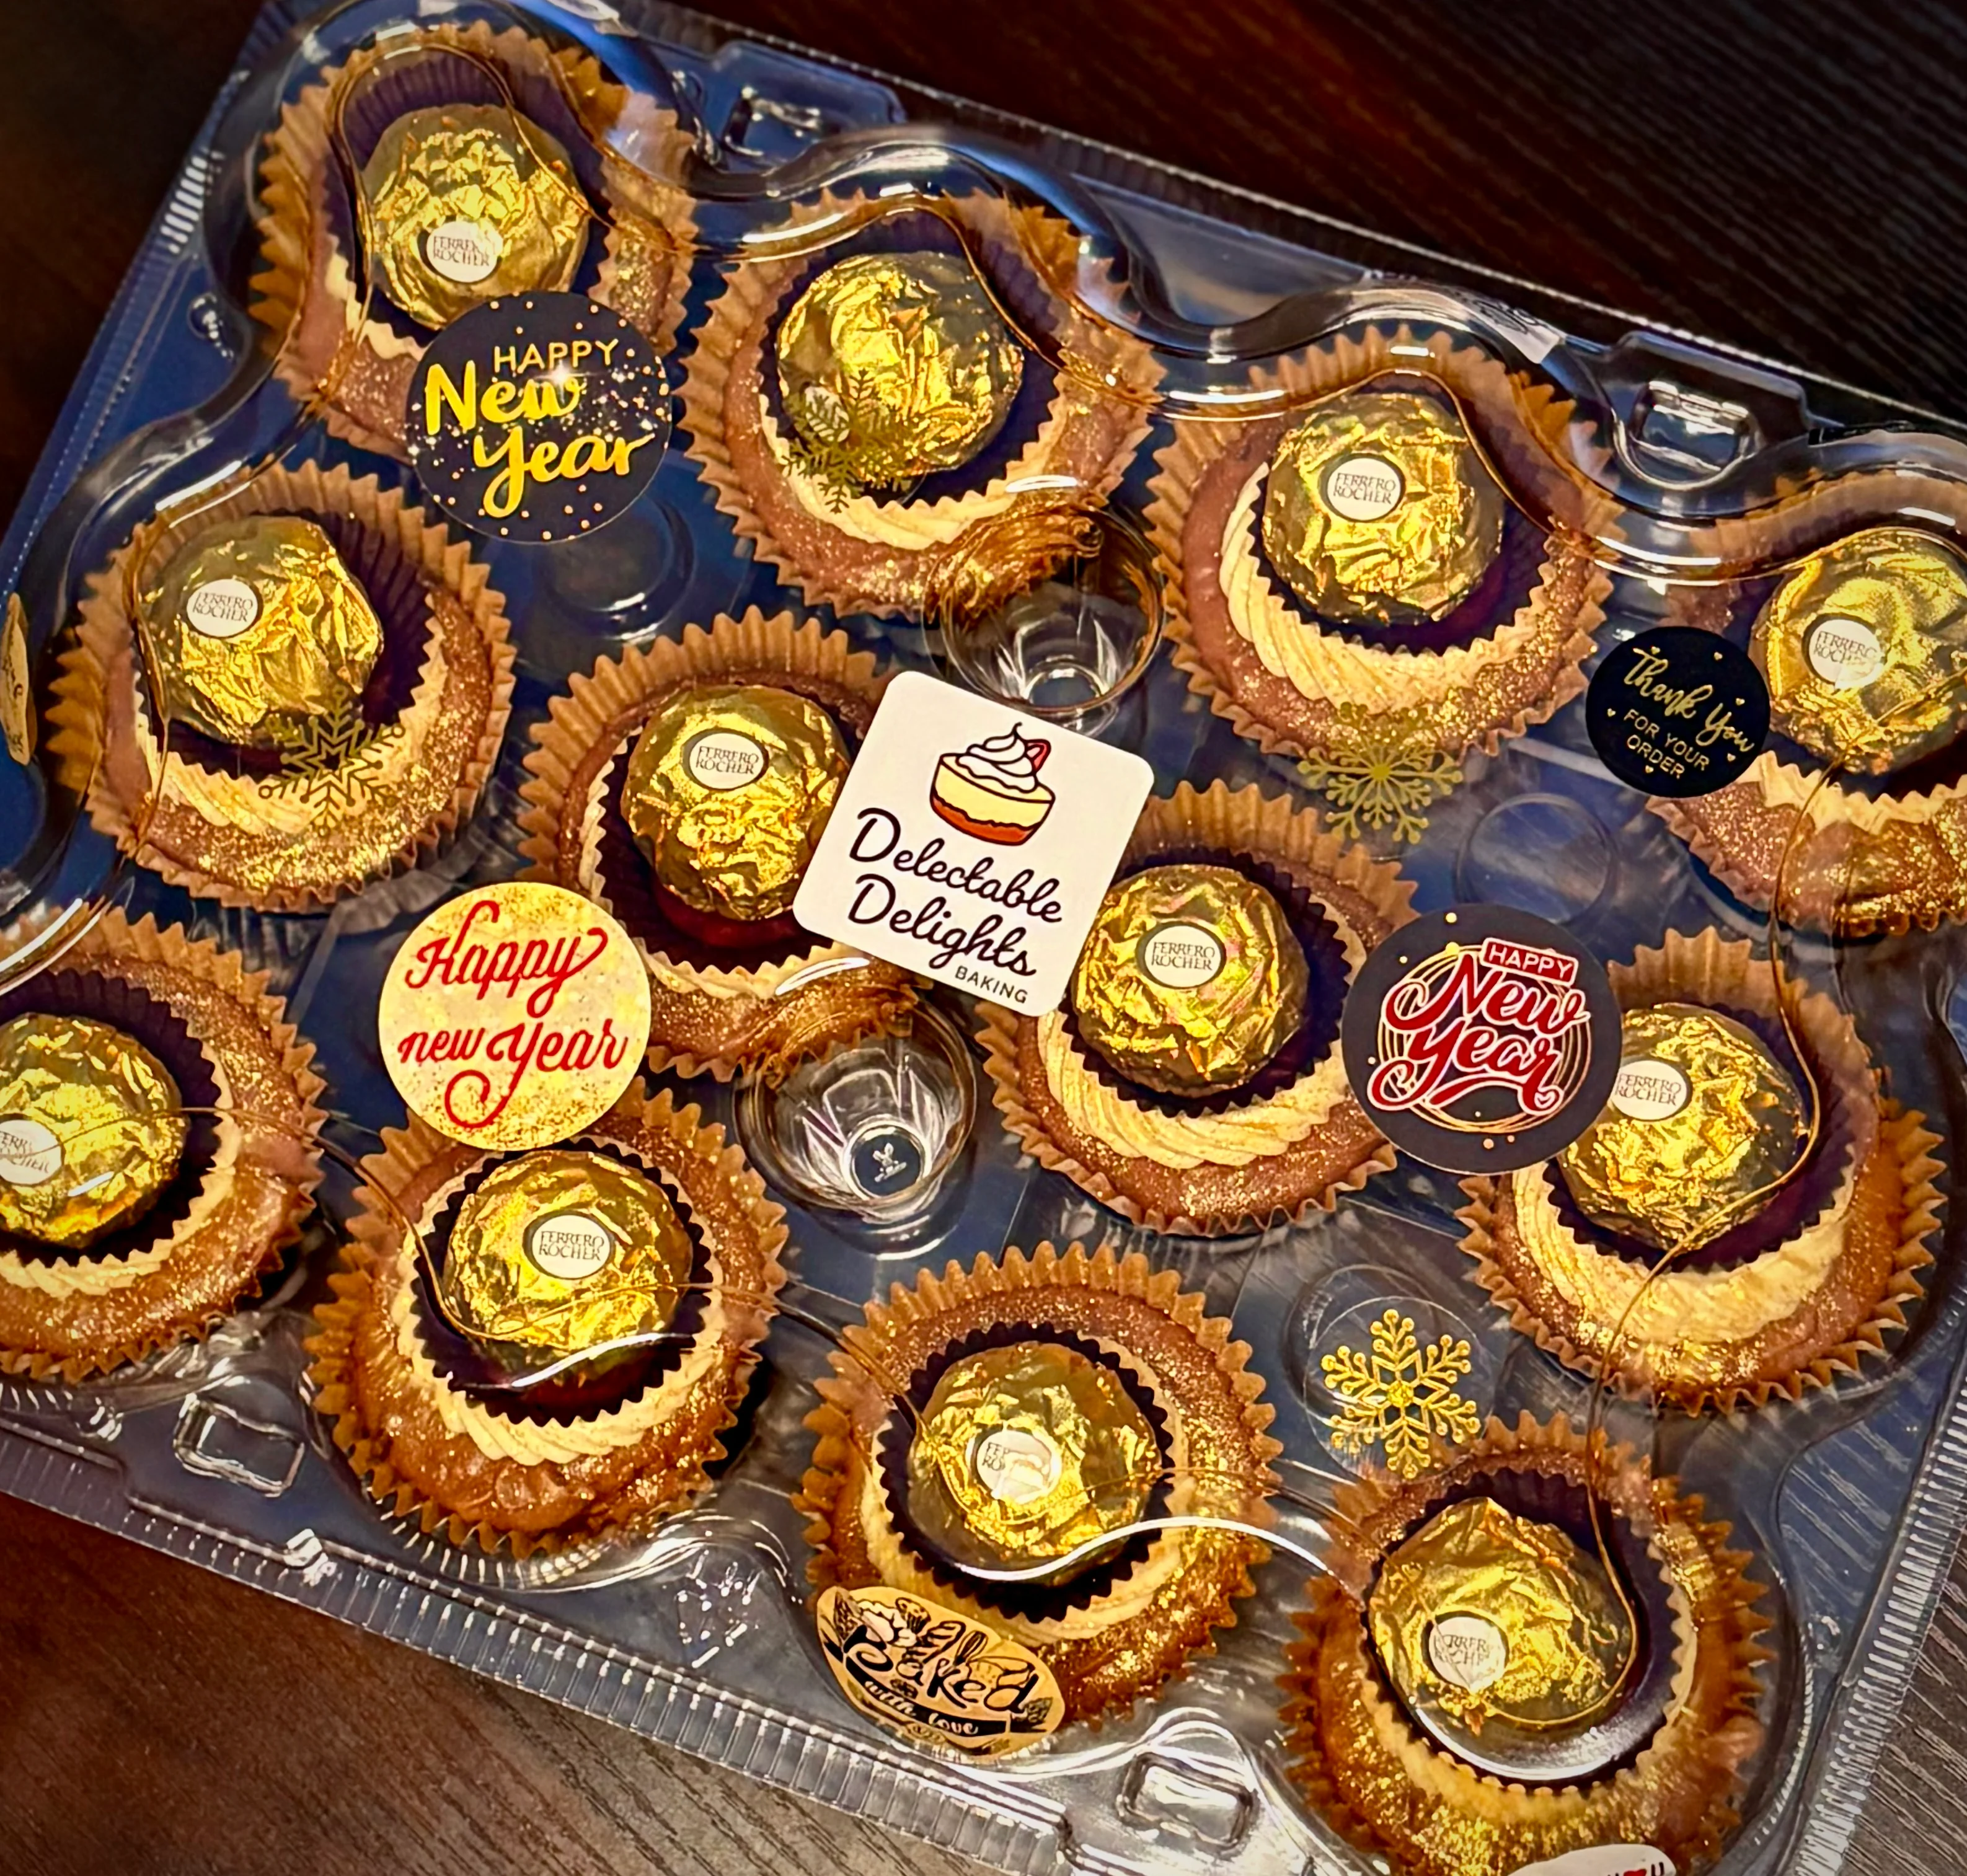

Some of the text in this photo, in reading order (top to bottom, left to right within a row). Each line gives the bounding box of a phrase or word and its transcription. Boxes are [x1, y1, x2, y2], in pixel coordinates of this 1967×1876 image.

[433, 249, 490, 266] ROCHER
[494, 338, 619, 374] HAPPY
[425, 359, 588, 436] New
[1333, 486, 1392, 505] ROCHER
[1335, 472, 1397, 492] FERRERO
[192, 602, 248, 623] ROCHER
[193, 591, 254, 611] FERRERO
[1624, 648, 1713, 719] Thank
[698, 746, 759, 764] FERRERO
[1624, 709, 1710, 771] FOR YOUR
[1627, 734, 1685, 779] ORDER
[696, 758, 754, 775] ROCHER
[849, 808, 1063, 923] Delectable
[847, 873, 1037, 977] Delights
[405, 900, 608, 1018] Happy
[1151, 954, 1213, 971] ROCHER
[1153, 941, 1216, 958] FERRERO
[1488, 944, 1573, 979] HAPPY
[955, 965, 1028, 1004] BAKING
[1381, 952, 1591, 1037] New
[397, 1028, 486, 1064] new
[1367, 1016, 1565, 1116] Year
[1617, 1073, 1681, 1094] FERRERO
[1615, 1085, 1676, 1106] ROCHER
[538, 1242, 601, 1261] ROCHER
[541, 1230, 604, 1248] FERRERO
[843, 1624, 1040, 1714] Baked
